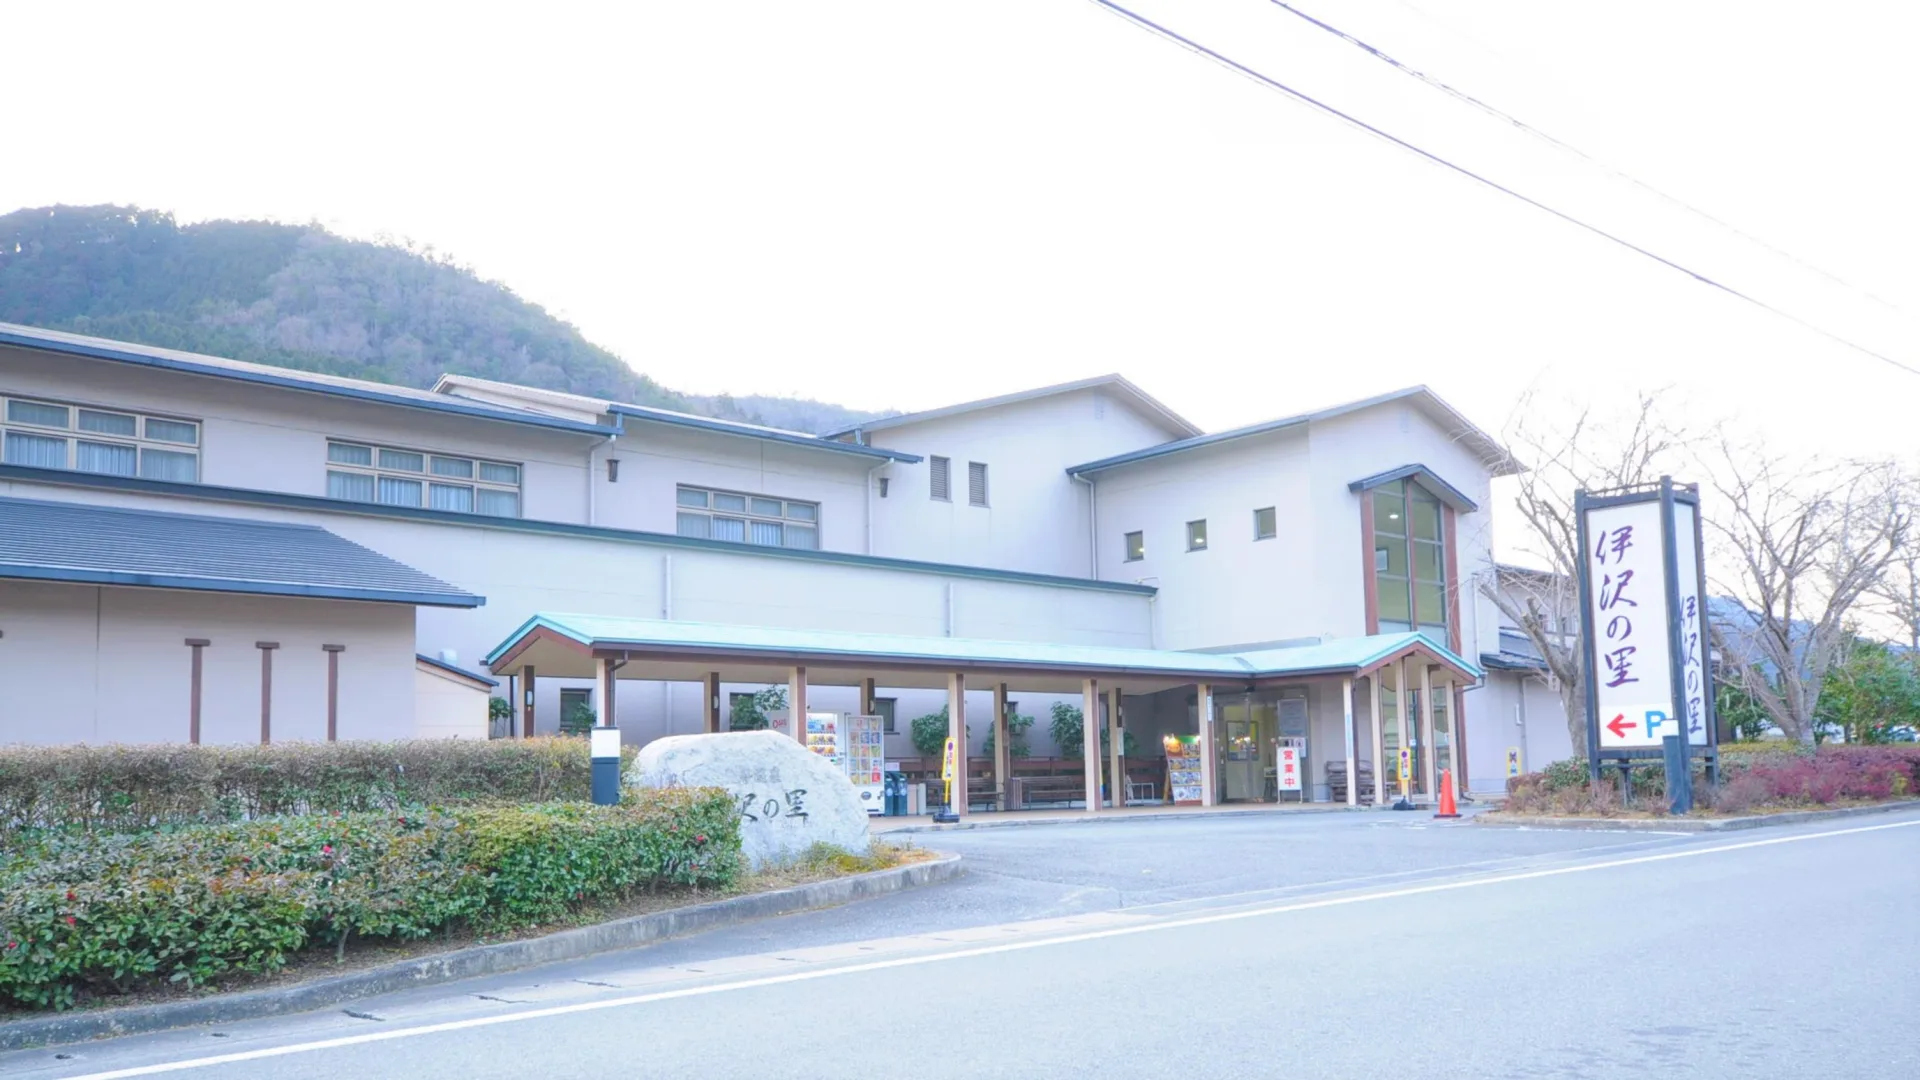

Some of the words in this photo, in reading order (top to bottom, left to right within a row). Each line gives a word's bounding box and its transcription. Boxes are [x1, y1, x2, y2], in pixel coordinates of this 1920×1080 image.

[1595, 525, 1640, 689] 伊沢の里
[1680, 595, 1703, 734] 伊沢の里
[1645, 710, 1667, 738] P
